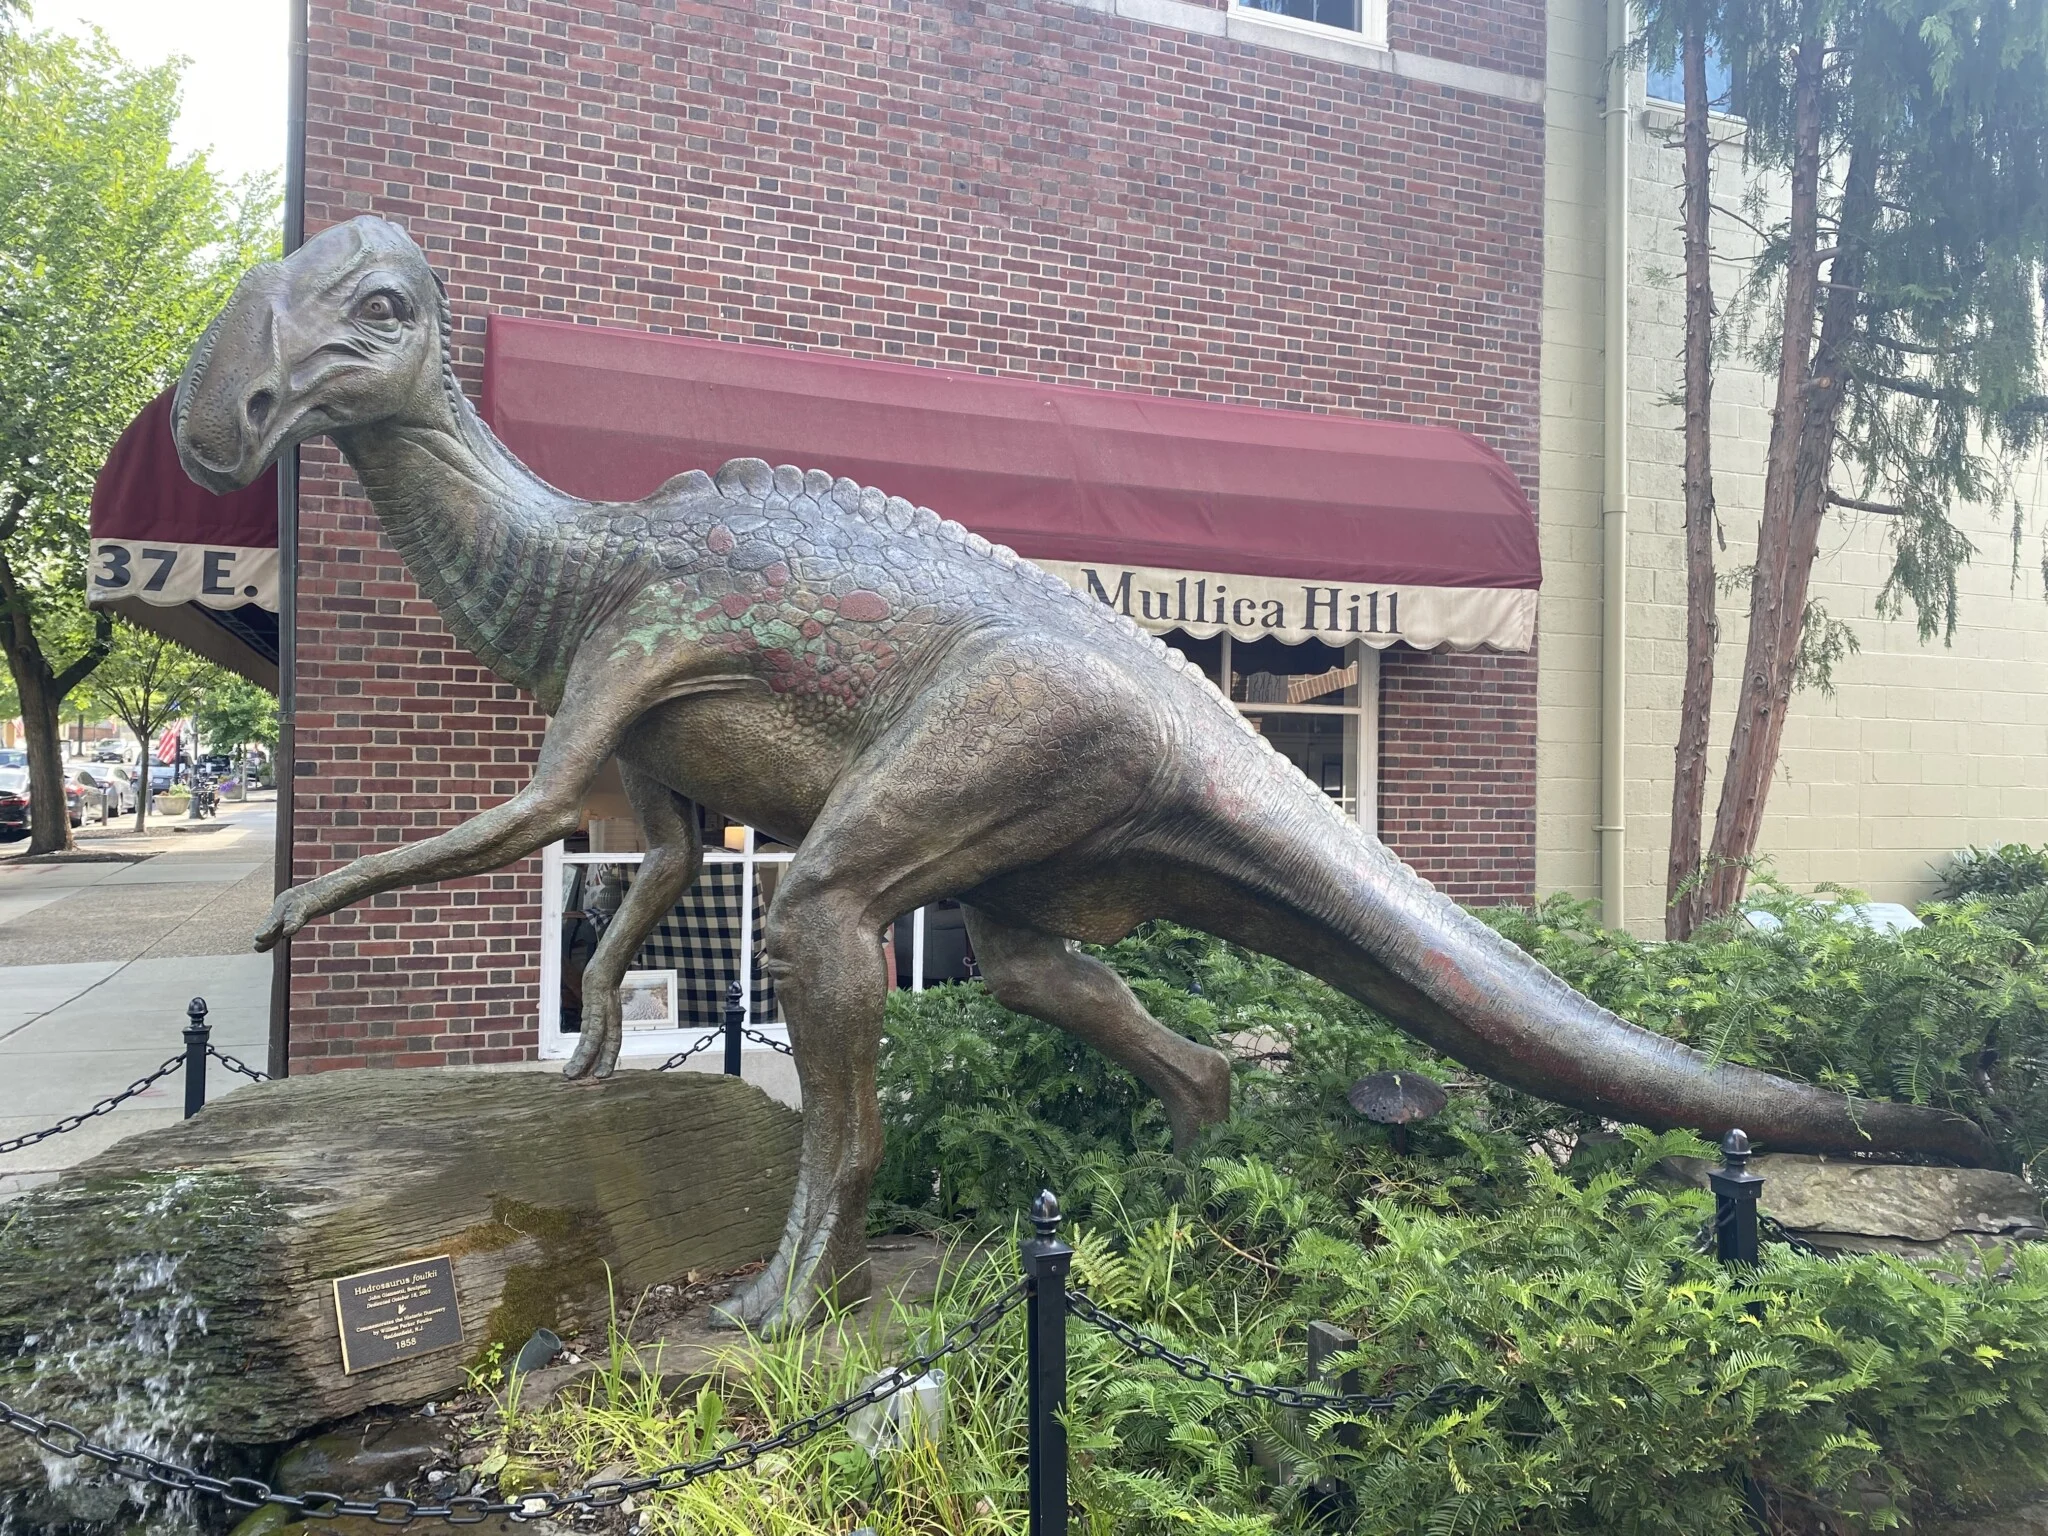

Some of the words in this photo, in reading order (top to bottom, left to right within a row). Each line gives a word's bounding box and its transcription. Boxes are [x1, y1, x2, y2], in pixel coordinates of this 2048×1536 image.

[94, 544, 178, 592] 37
[202, 550, 258, 597] E.
[1081, 568, 1286, 629] Mullica
[1300, 585, 1403, 635] Hill
[354, 1277, 410, 1296] Hadrosaurus
[411, 1269, 438, 1284] foulkii
[395, 1337, 417, 1350] 1858
